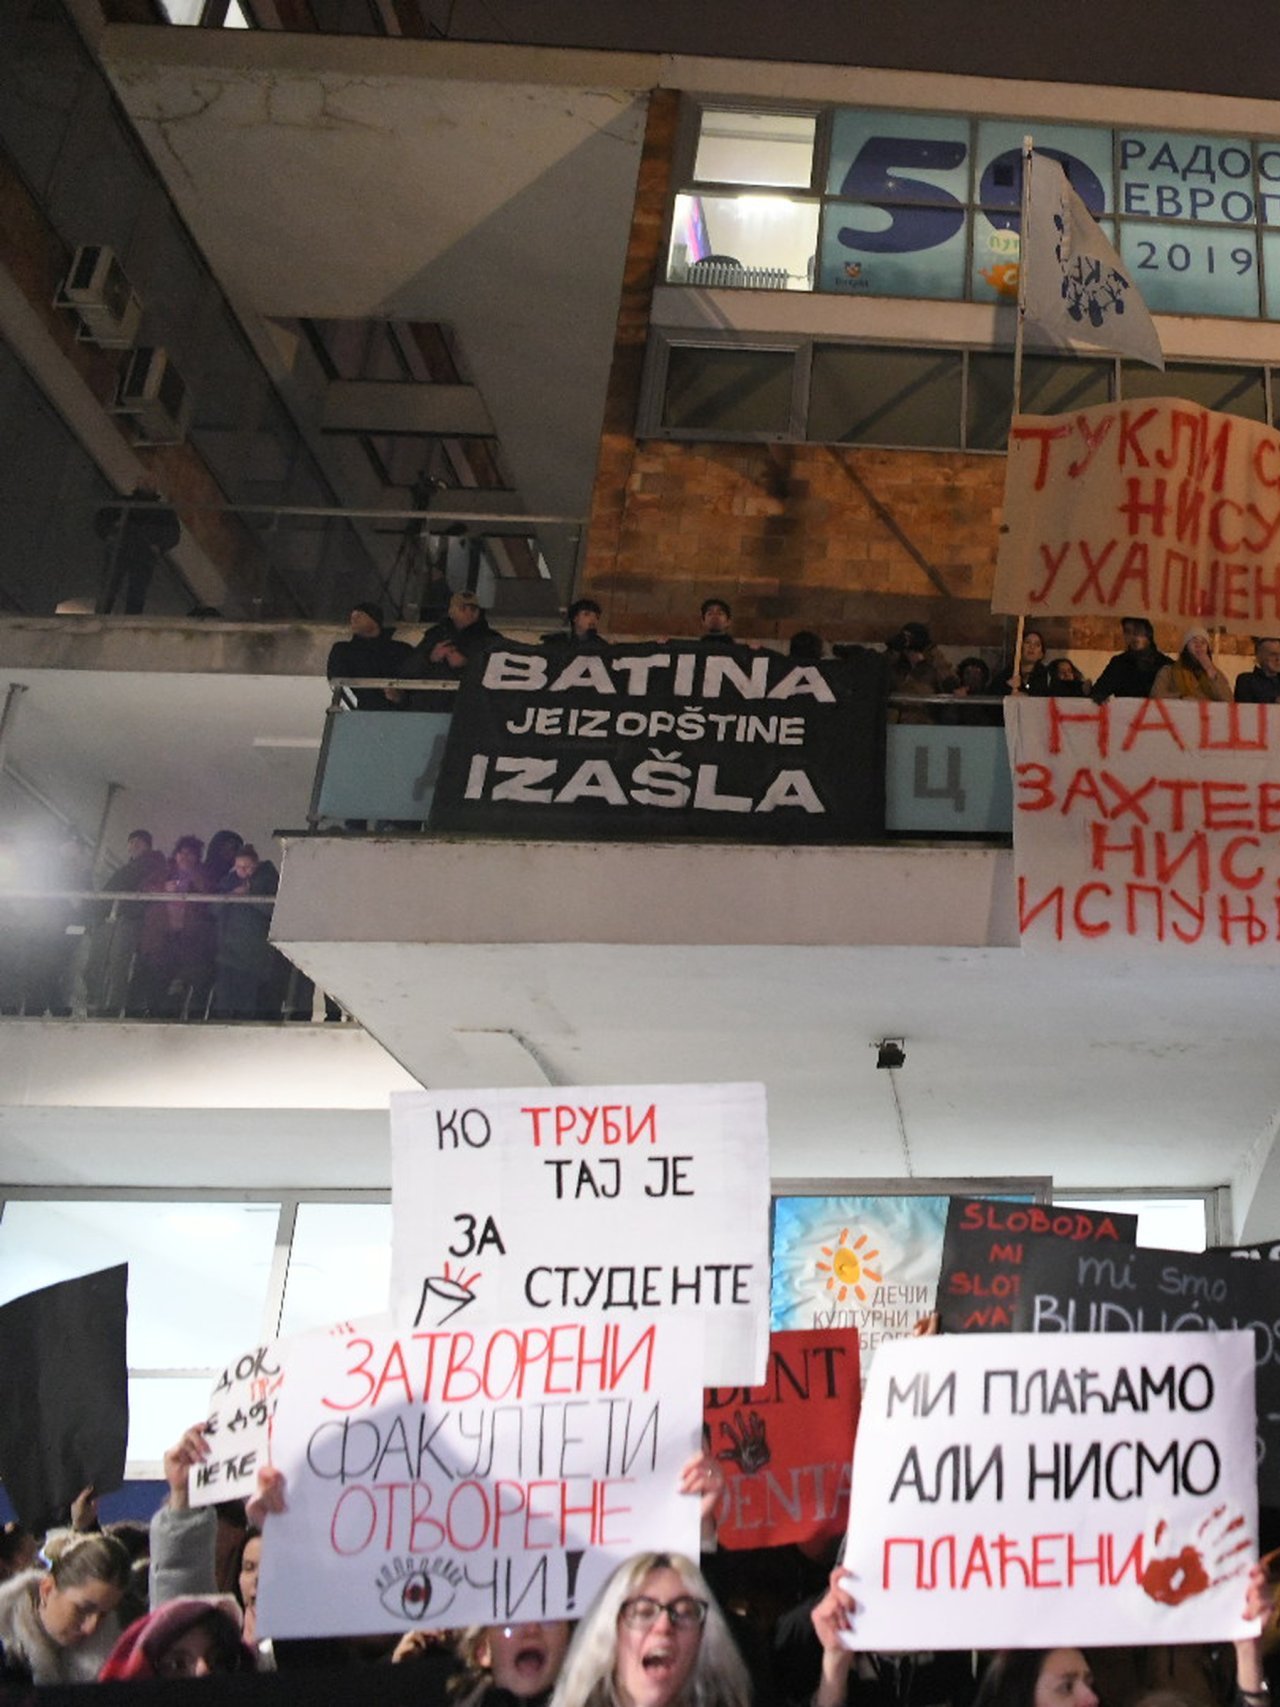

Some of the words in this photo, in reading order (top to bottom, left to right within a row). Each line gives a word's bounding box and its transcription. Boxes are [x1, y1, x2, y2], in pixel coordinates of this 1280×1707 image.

[1137, 241, 1253, 276] 2019
[1012, 407, 1233, 492] ТУКЛИ
[481, 651, 837, 703] BATINA
[614, 705, 806, 746] OPŠTINE
[463, 747, 826, 814] IZAŠLA
[435, 1107, 493, 1151] КО
[520, 1103, 658, 1147] ТРУБИ
[544, 1157, 622, 1200] ТАЈ
[644, 1155, 695, 1198] ЈЕ
[448, 1212, 507, 1258] ЗА
[958, 1201, 1122, 1243] SLOBODA
[524, 1263, 755, 1311] СТУДЕНТЕ
[871, 1285, 929, 1308] ДЕЧЈИ
[1077, 1252, 1138, 1291] mi
[1157, 1266, 1228, 1302] smo
[812, 1309, 909, 1331] КУЛТУРНИ
[321, 1323, 657, 1411] ЗАТВОРЕНИ
[886, 1370, 957, 1419] МИ
[982, 1363, 1215, 1416] ПЛАЋАМО
[306, 1399, 660, 1485] ФАКУЛТЕТИ
[888, 1443, 1004, 1503] АЛИ
[1026, 1438, 1221, 1503] НИСМО
[330, 1477, 638, 1557] ОТВОРЕНЕ
[882, 1531, 1145, 1592] ПЛАЋЕНИ
